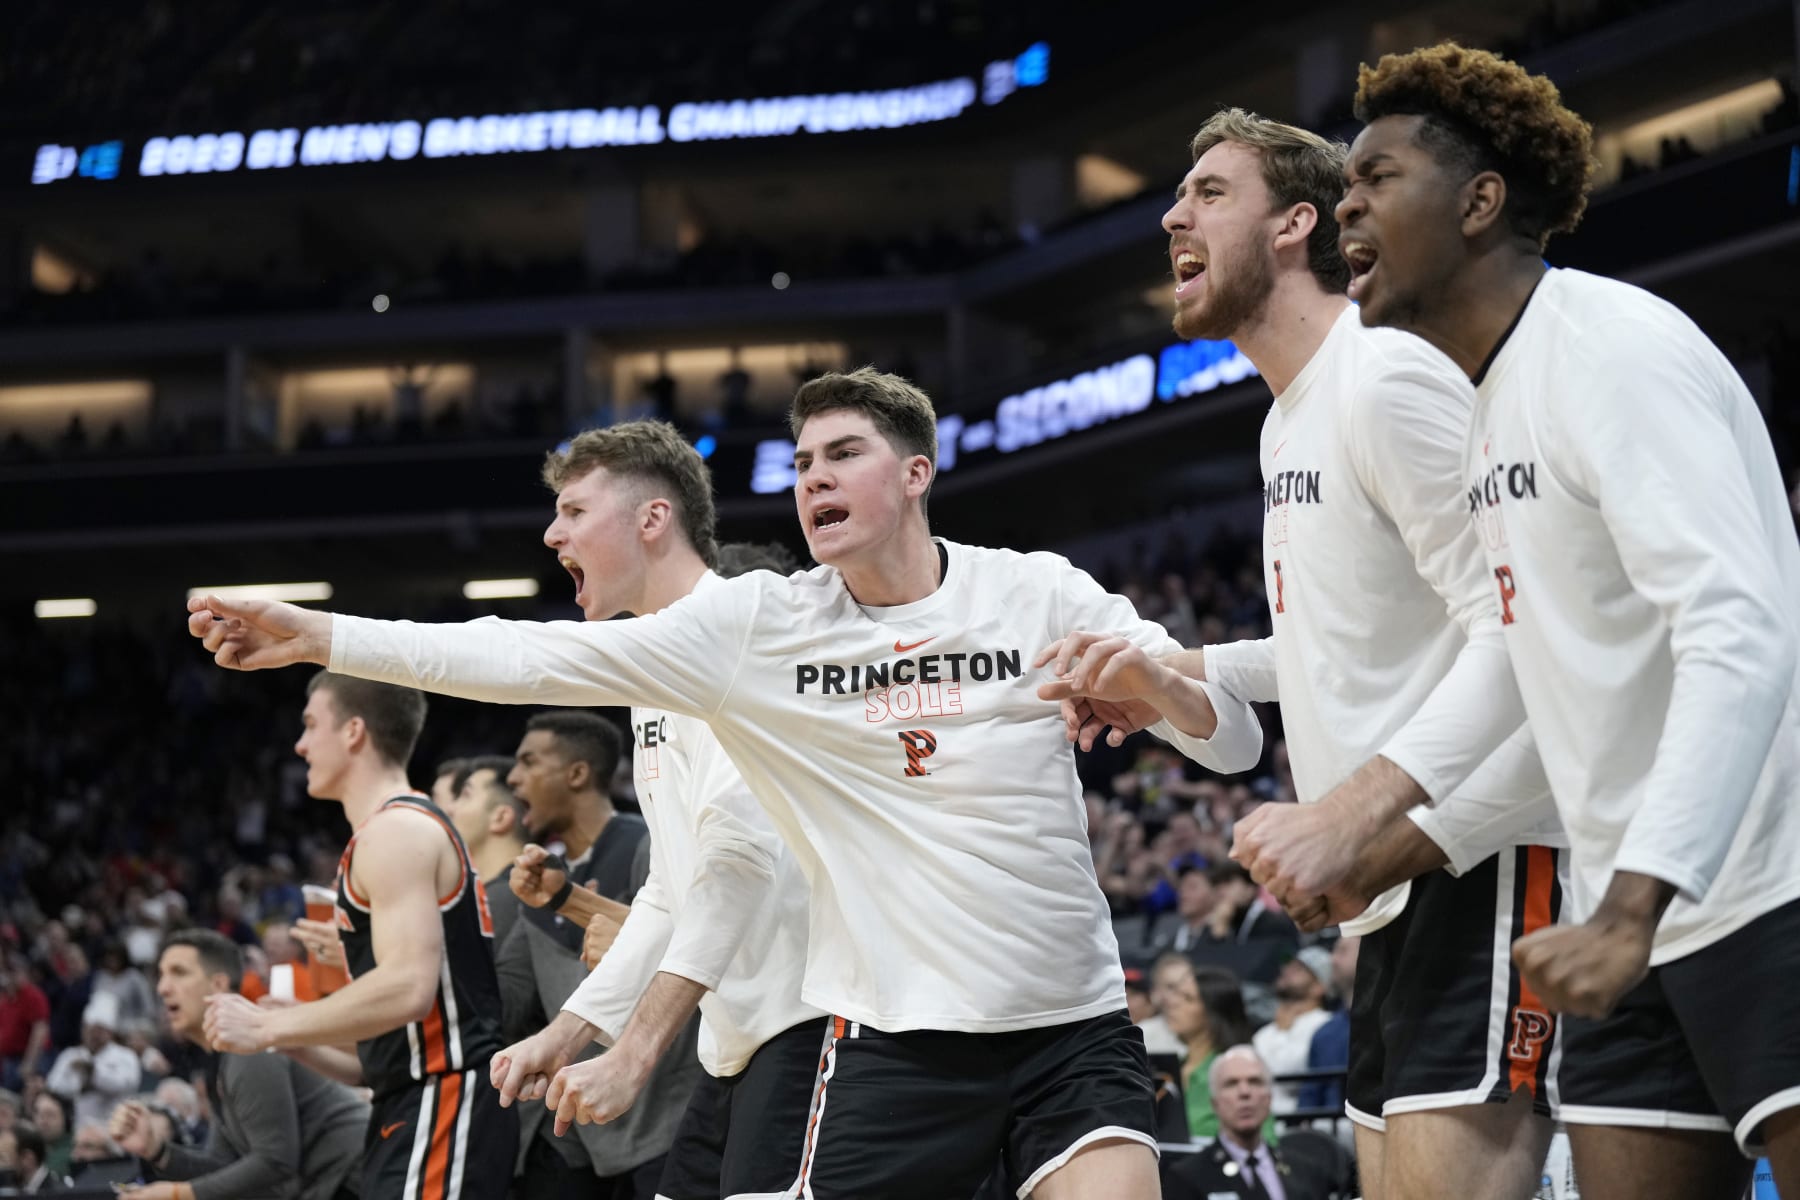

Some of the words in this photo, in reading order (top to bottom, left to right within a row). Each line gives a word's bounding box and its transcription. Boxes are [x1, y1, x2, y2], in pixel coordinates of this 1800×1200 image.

[422, 105, 666, 158] BASKETBALL
[667, 78, 976, 142] CHAMPIONSHIP
[796, 649, 1022, 695] PRINCETON
[864, 679, 963, 723] SOLE
[898, 729, 937, 777] P
[1508, 1007, 1552, 1060] P
